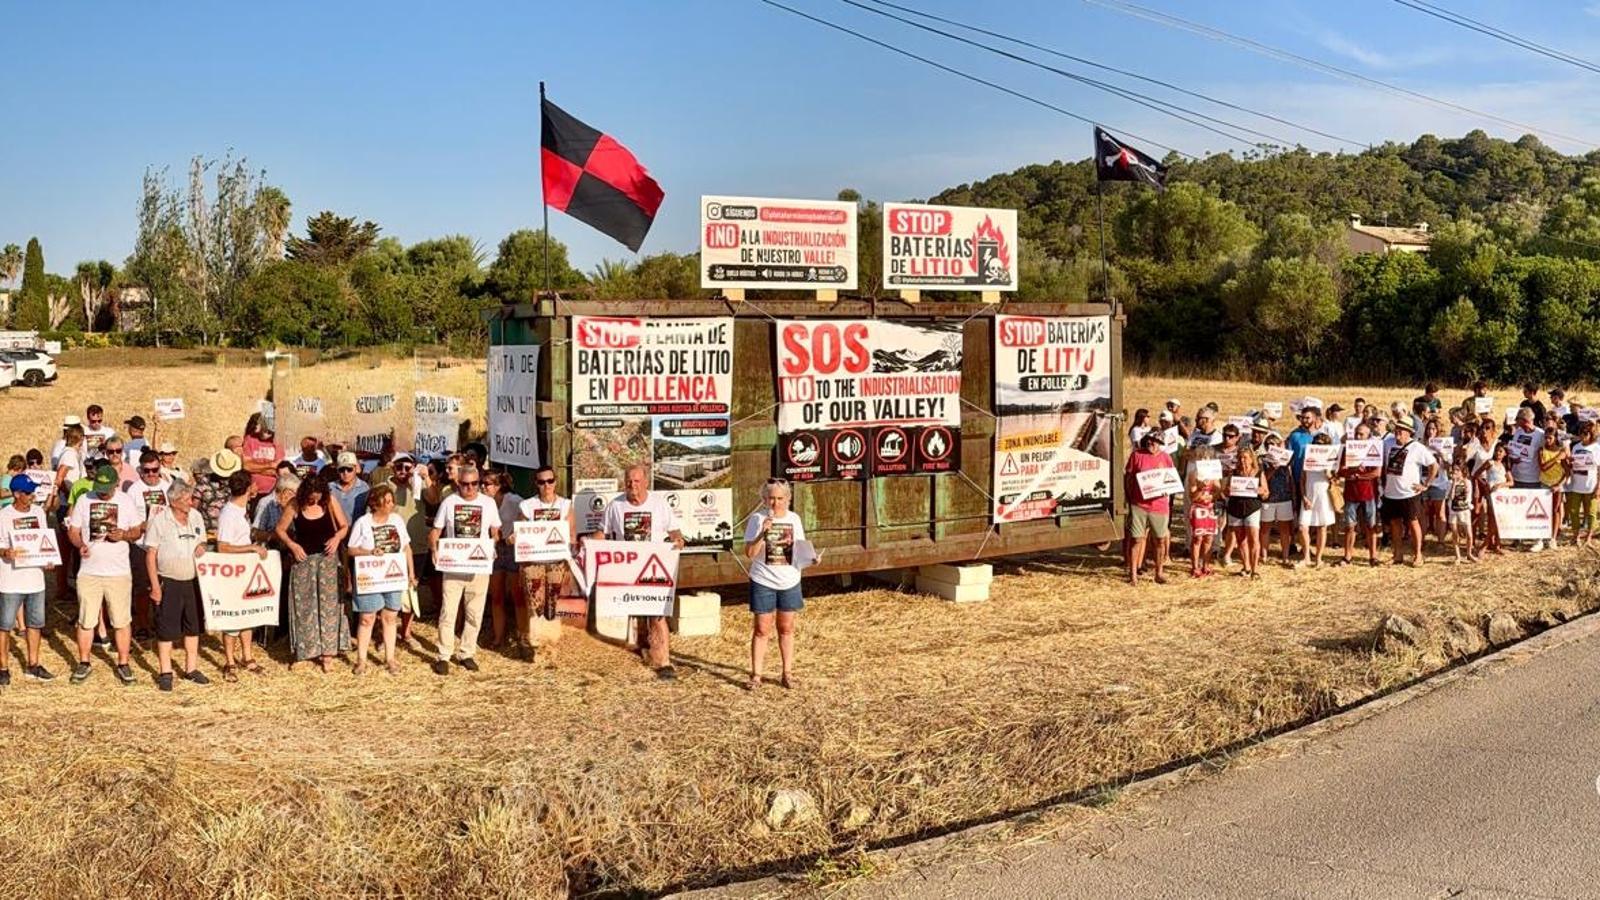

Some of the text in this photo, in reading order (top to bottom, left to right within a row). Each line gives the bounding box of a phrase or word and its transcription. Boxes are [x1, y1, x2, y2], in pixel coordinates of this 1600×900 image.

[896, 210, 946, 233] STOP
[741, 230, 747, 244] A
[749, 230, 760, 245] LA
[762, 229, 846, 248] INDUSTRIALIZACIÓN
[891, 233, 973, 258] BATERÍAS
[741, 248, 836, 264] DE NUESTRO VALLE!
[891, 258, 963, 276] DE LITIO
[585, 320, 637, 346] STOP
[1004, 318, 1105, 345] STOP BATERÍAS
[782, 322, 871, 375] SOS
[521, 354, 534, 373] DE
[578, 346, 730, 375] BATERÍAS DE LITIO
[1017, 349, 1037, 373] DE
[589, 376, 717, 403] EN POLLENÇA
[782, 375, 961, 402] NO TO THE INDUSTRIALISATION
[1028, 378, 1039, 390] EN
[803, 397, 945, 424] OF OUR VALLEY!
[1005, 439, 1021, 450] ZONA
[1495, 495, 1527, 505] STOP
[14, 533, 39, 542] STOP
[519, 526, 547, 535] STOP
[444, 542, 471, 550] STOP
[197, 563, 246, 578] STOP
[359, 560, 386, 569] STOP
